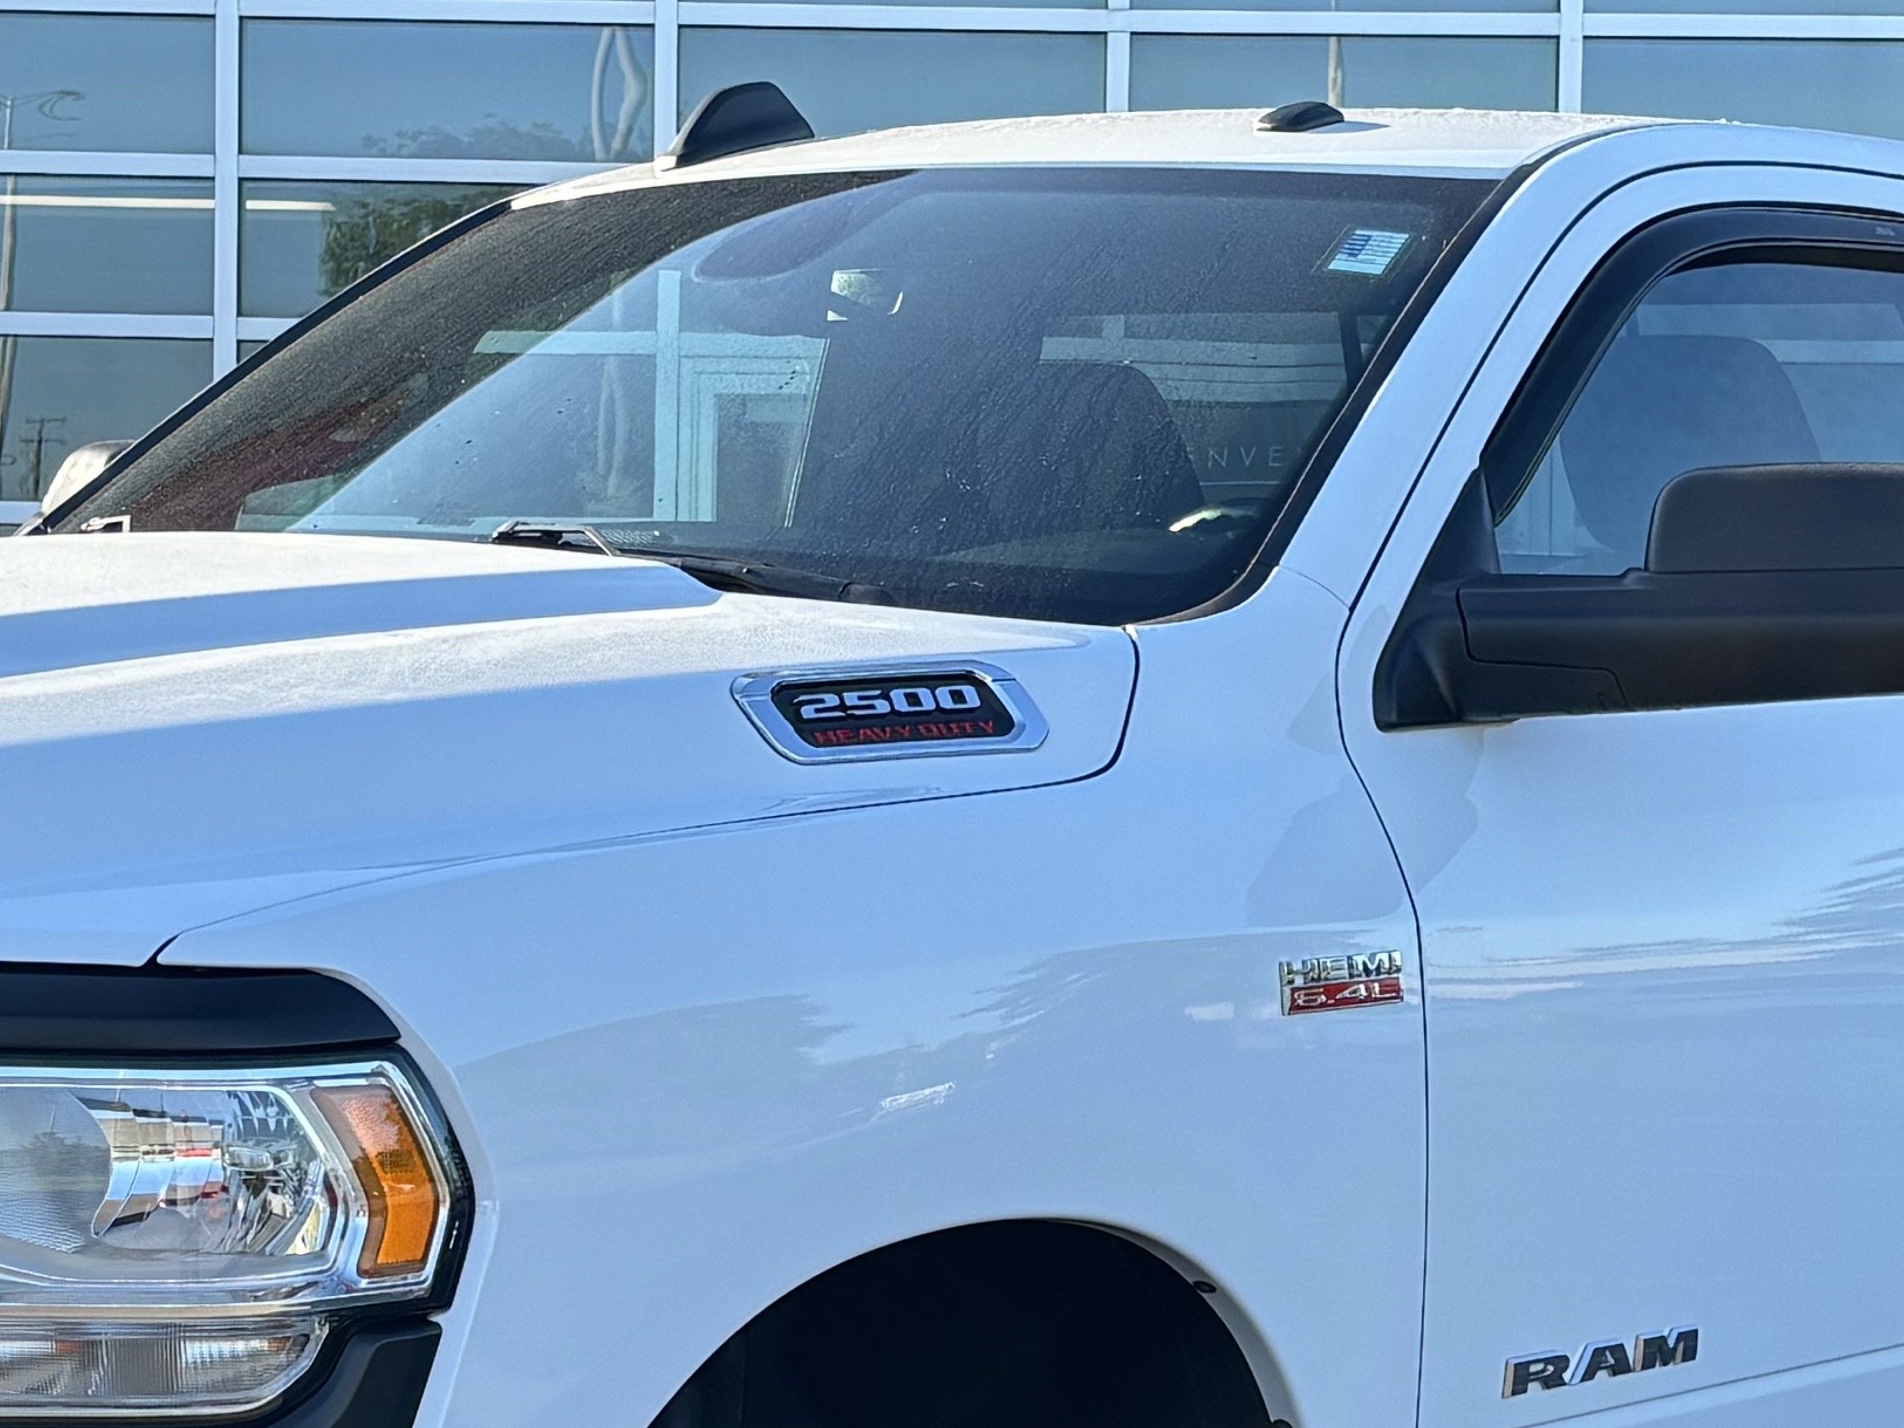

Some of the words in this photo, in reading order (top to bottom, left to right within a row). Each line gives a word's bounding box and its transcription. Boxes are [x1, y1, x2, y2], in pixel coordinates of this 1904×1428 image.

[793, 684, 981, 719] 2500
[813, 723, 911, 745] HEAVY
[917, 720, 994, 738] DUTY
[1279, 949, 1403, 986] HEMI
[1502, 1325, 1699, 1400] RAM
